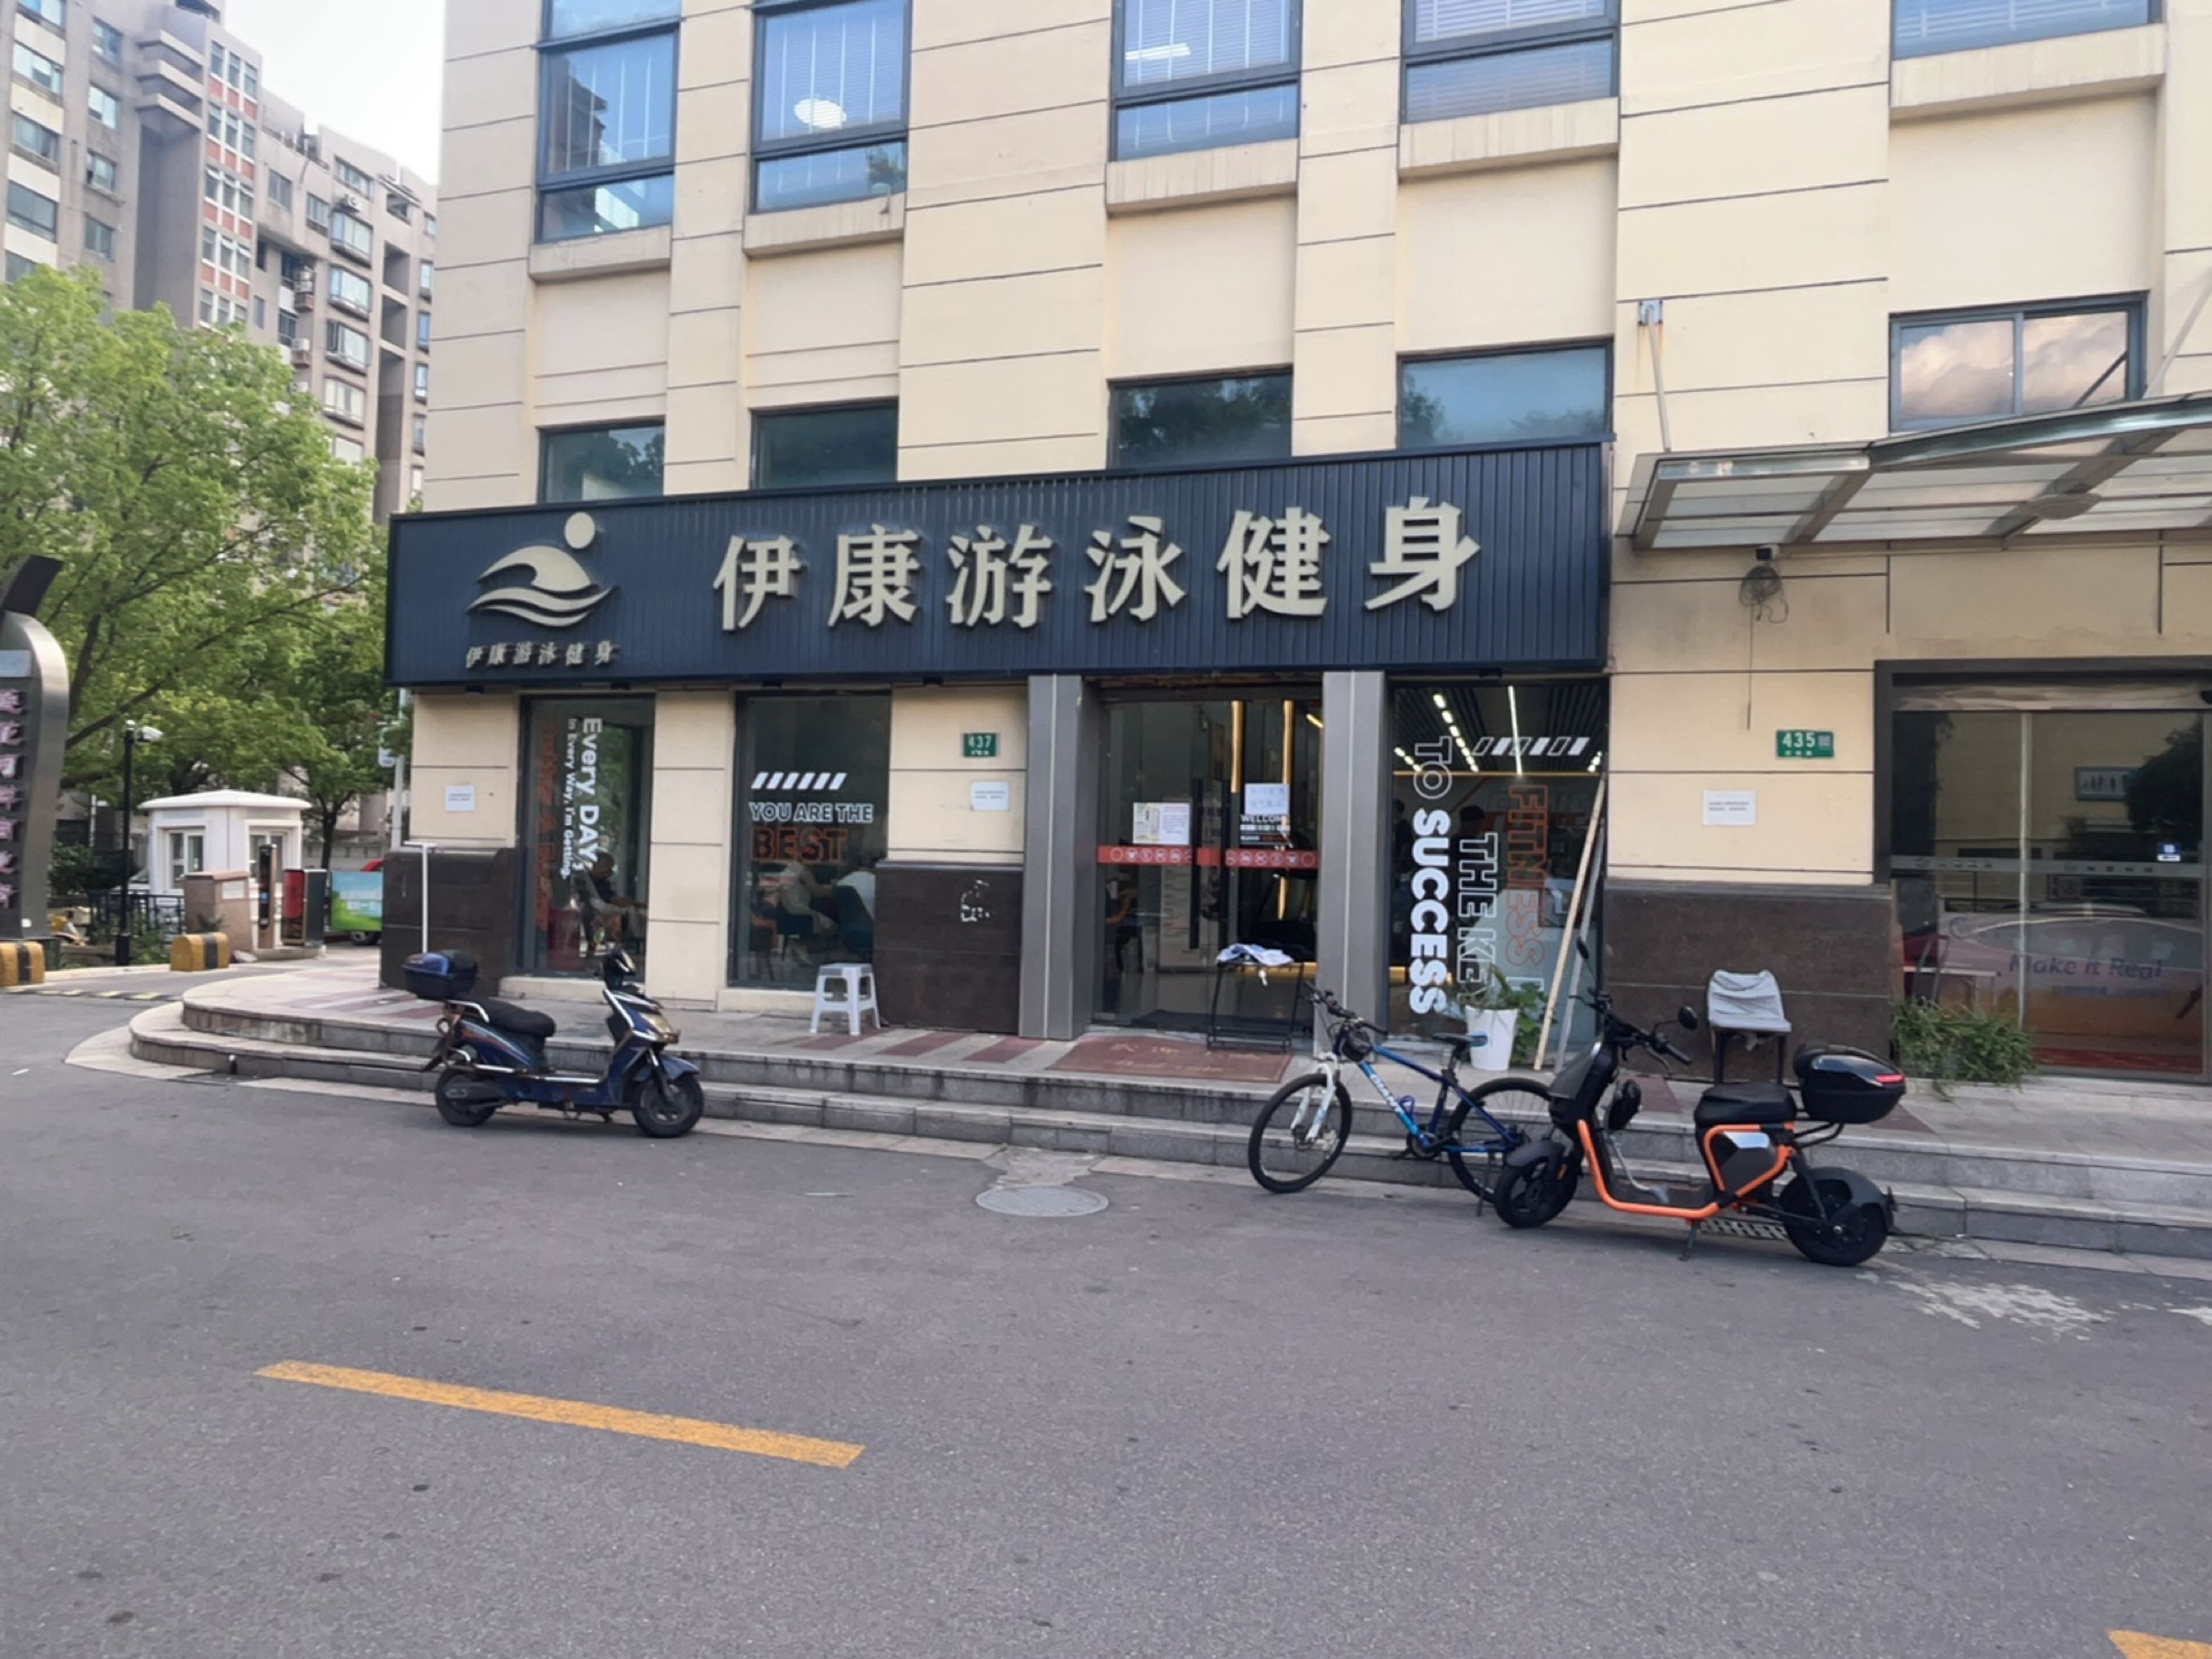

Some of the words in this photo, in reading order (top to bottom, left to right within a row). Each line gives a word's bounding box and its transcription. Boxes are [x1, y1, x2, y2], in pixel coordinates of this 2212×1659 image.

[712, 496, 1482, 632] 伊康游泳健身
[465, 640, 614, 668] 伊康游泳健身
[568, 718, 577, 732] In
[968, 735, 991, 748] 437
[1781, 732, 1816, 748] 435
[565, 733, 577, 769] Every
[575, 717, 603, 796] Every
[1413, 735, 1453, 800] TO
[748, 801, 792, 822] YOU
[792, 802, 833, 823] ARE
[835, 803, 874, 824] THE
[750, 826, 849, 863] BEST
[1457, 832, 1499, 918] THE
[1505, 784, 1549, 966] FITNESS
[1409, 807, 1452, 1014] SUCCESS
[2109, 957, 2163, 980] Real
